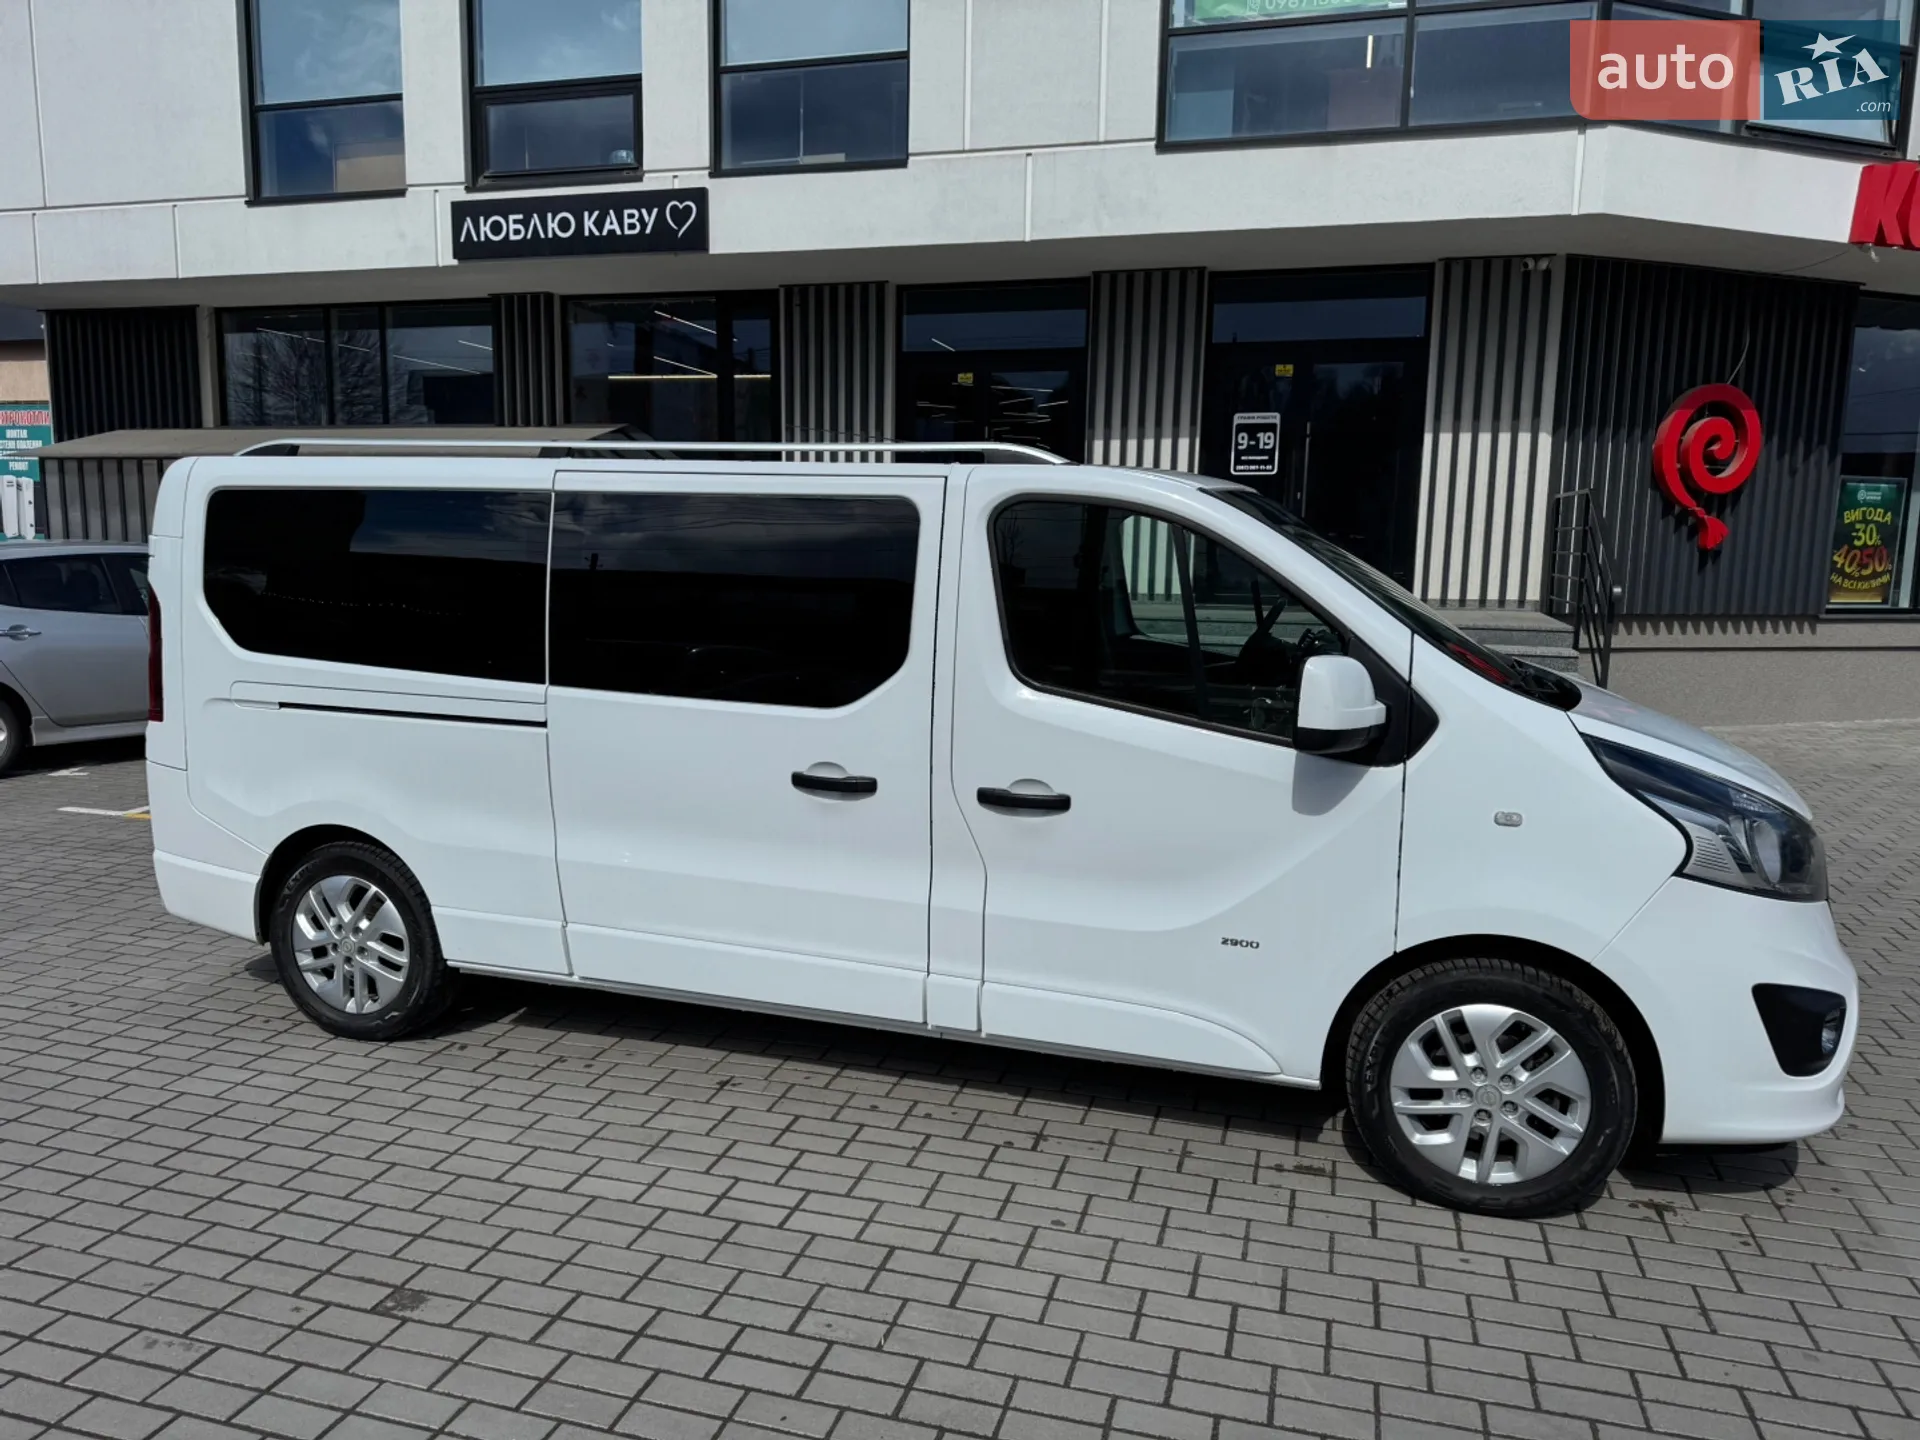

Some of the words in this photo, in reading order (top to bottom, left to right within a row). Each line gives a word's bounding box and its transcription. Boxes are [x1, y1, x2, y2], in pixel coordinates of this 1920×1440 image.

[460, 211, 576, 243] ЛЮБЛЮ
[583, 207, 659, 237] КАВУ
[1843, 506, 1892, 525] ВИГОДА
[1220, 937, 1260, 950] 2900
